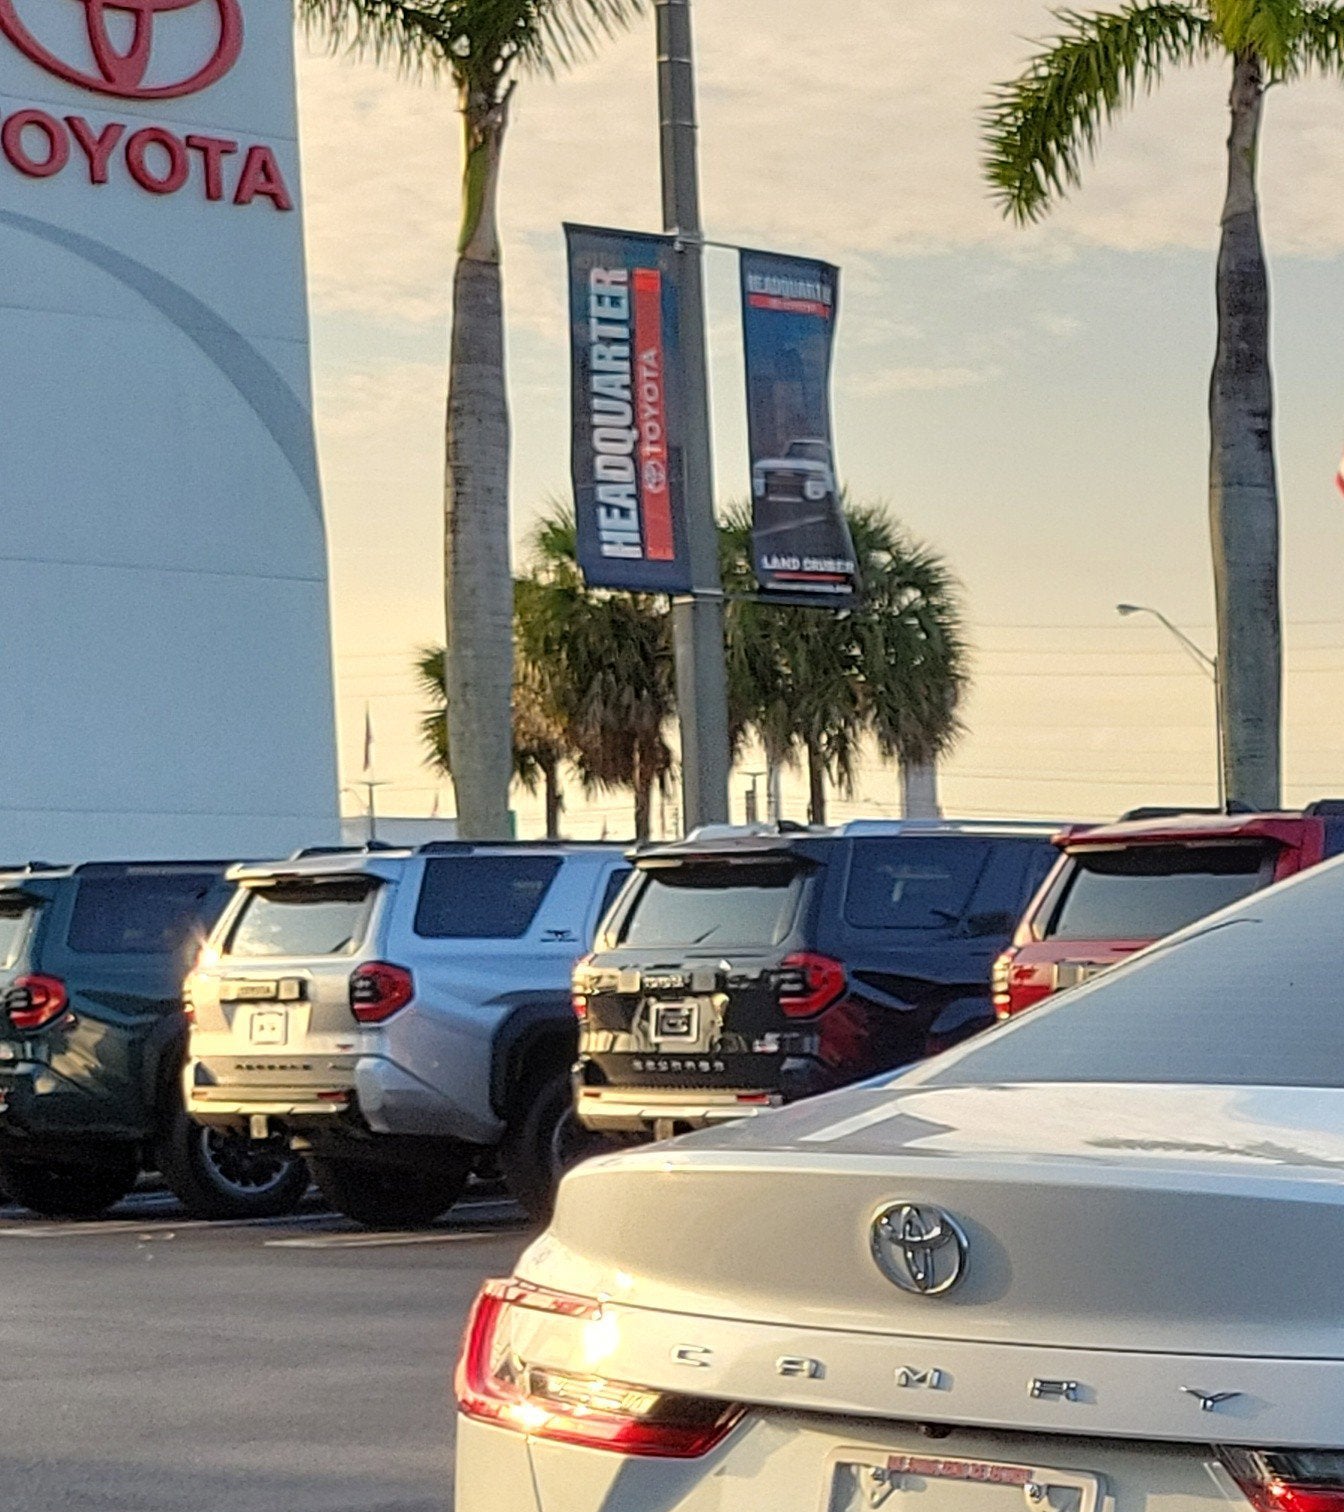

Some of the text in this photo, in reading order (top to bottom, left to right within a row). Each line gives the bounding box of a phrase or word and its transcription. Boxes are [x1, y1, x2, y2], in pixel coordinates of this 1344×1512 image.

[590, 267, 643, 559] HEADQUARTER
[641, 349, 663, 456] TOYOTA
[671, 1343, 1243, 1411] CAMRY
